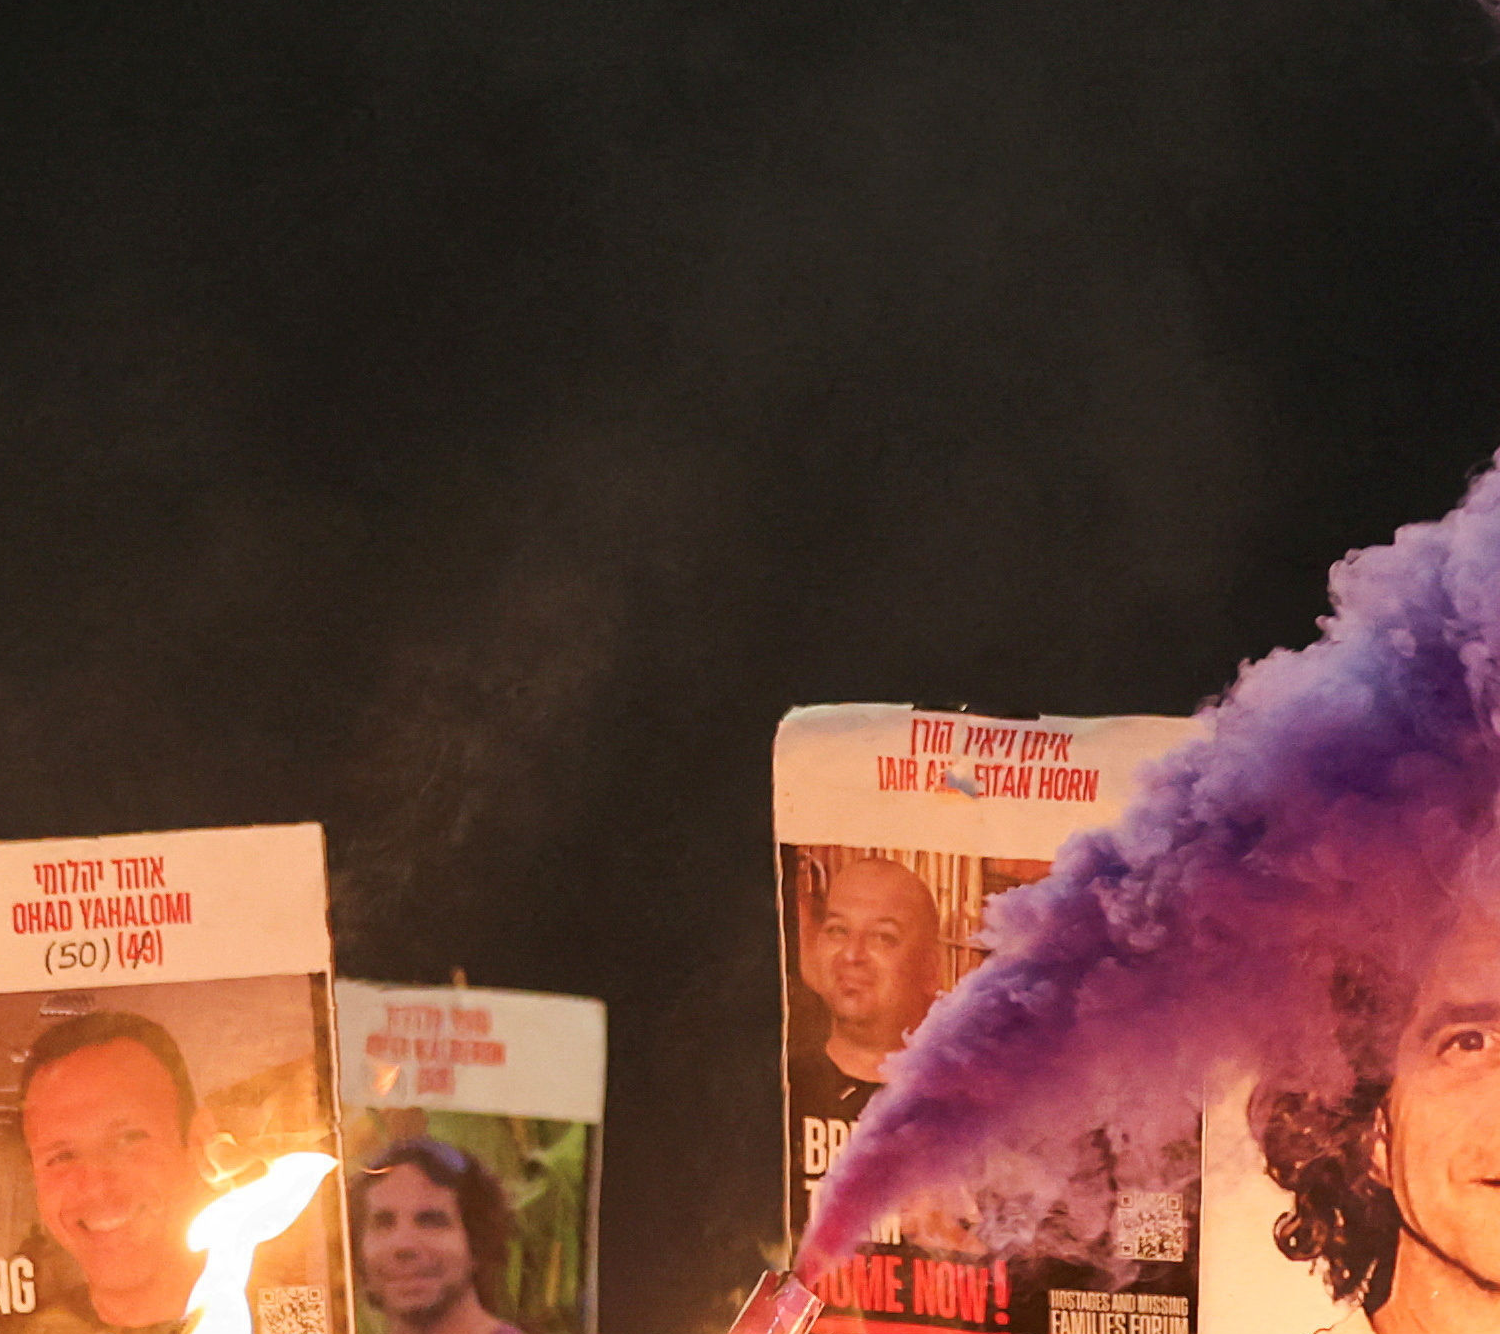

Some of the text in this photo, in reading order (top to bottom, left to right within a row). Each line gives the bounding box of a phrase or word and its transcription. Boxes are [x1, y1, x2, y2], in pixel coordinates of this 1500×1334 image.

[911, 718, 955, 756] הורן
[1020, 730, 1074, 763] איתן
[878, 755, 919, 791] IAIR
[1038, 766, 1099, 802] HORN
[34, 856, 166, 895] אוהד יהלומי
[12, 892, 192, 934] OHAD YAHALOMI
[45, 937, 111, 975] (50)
[912, 1257, 1012, 1325] NOW!
[1050, 1290, 1190, 1318] HOSTAGES AND MISSING
